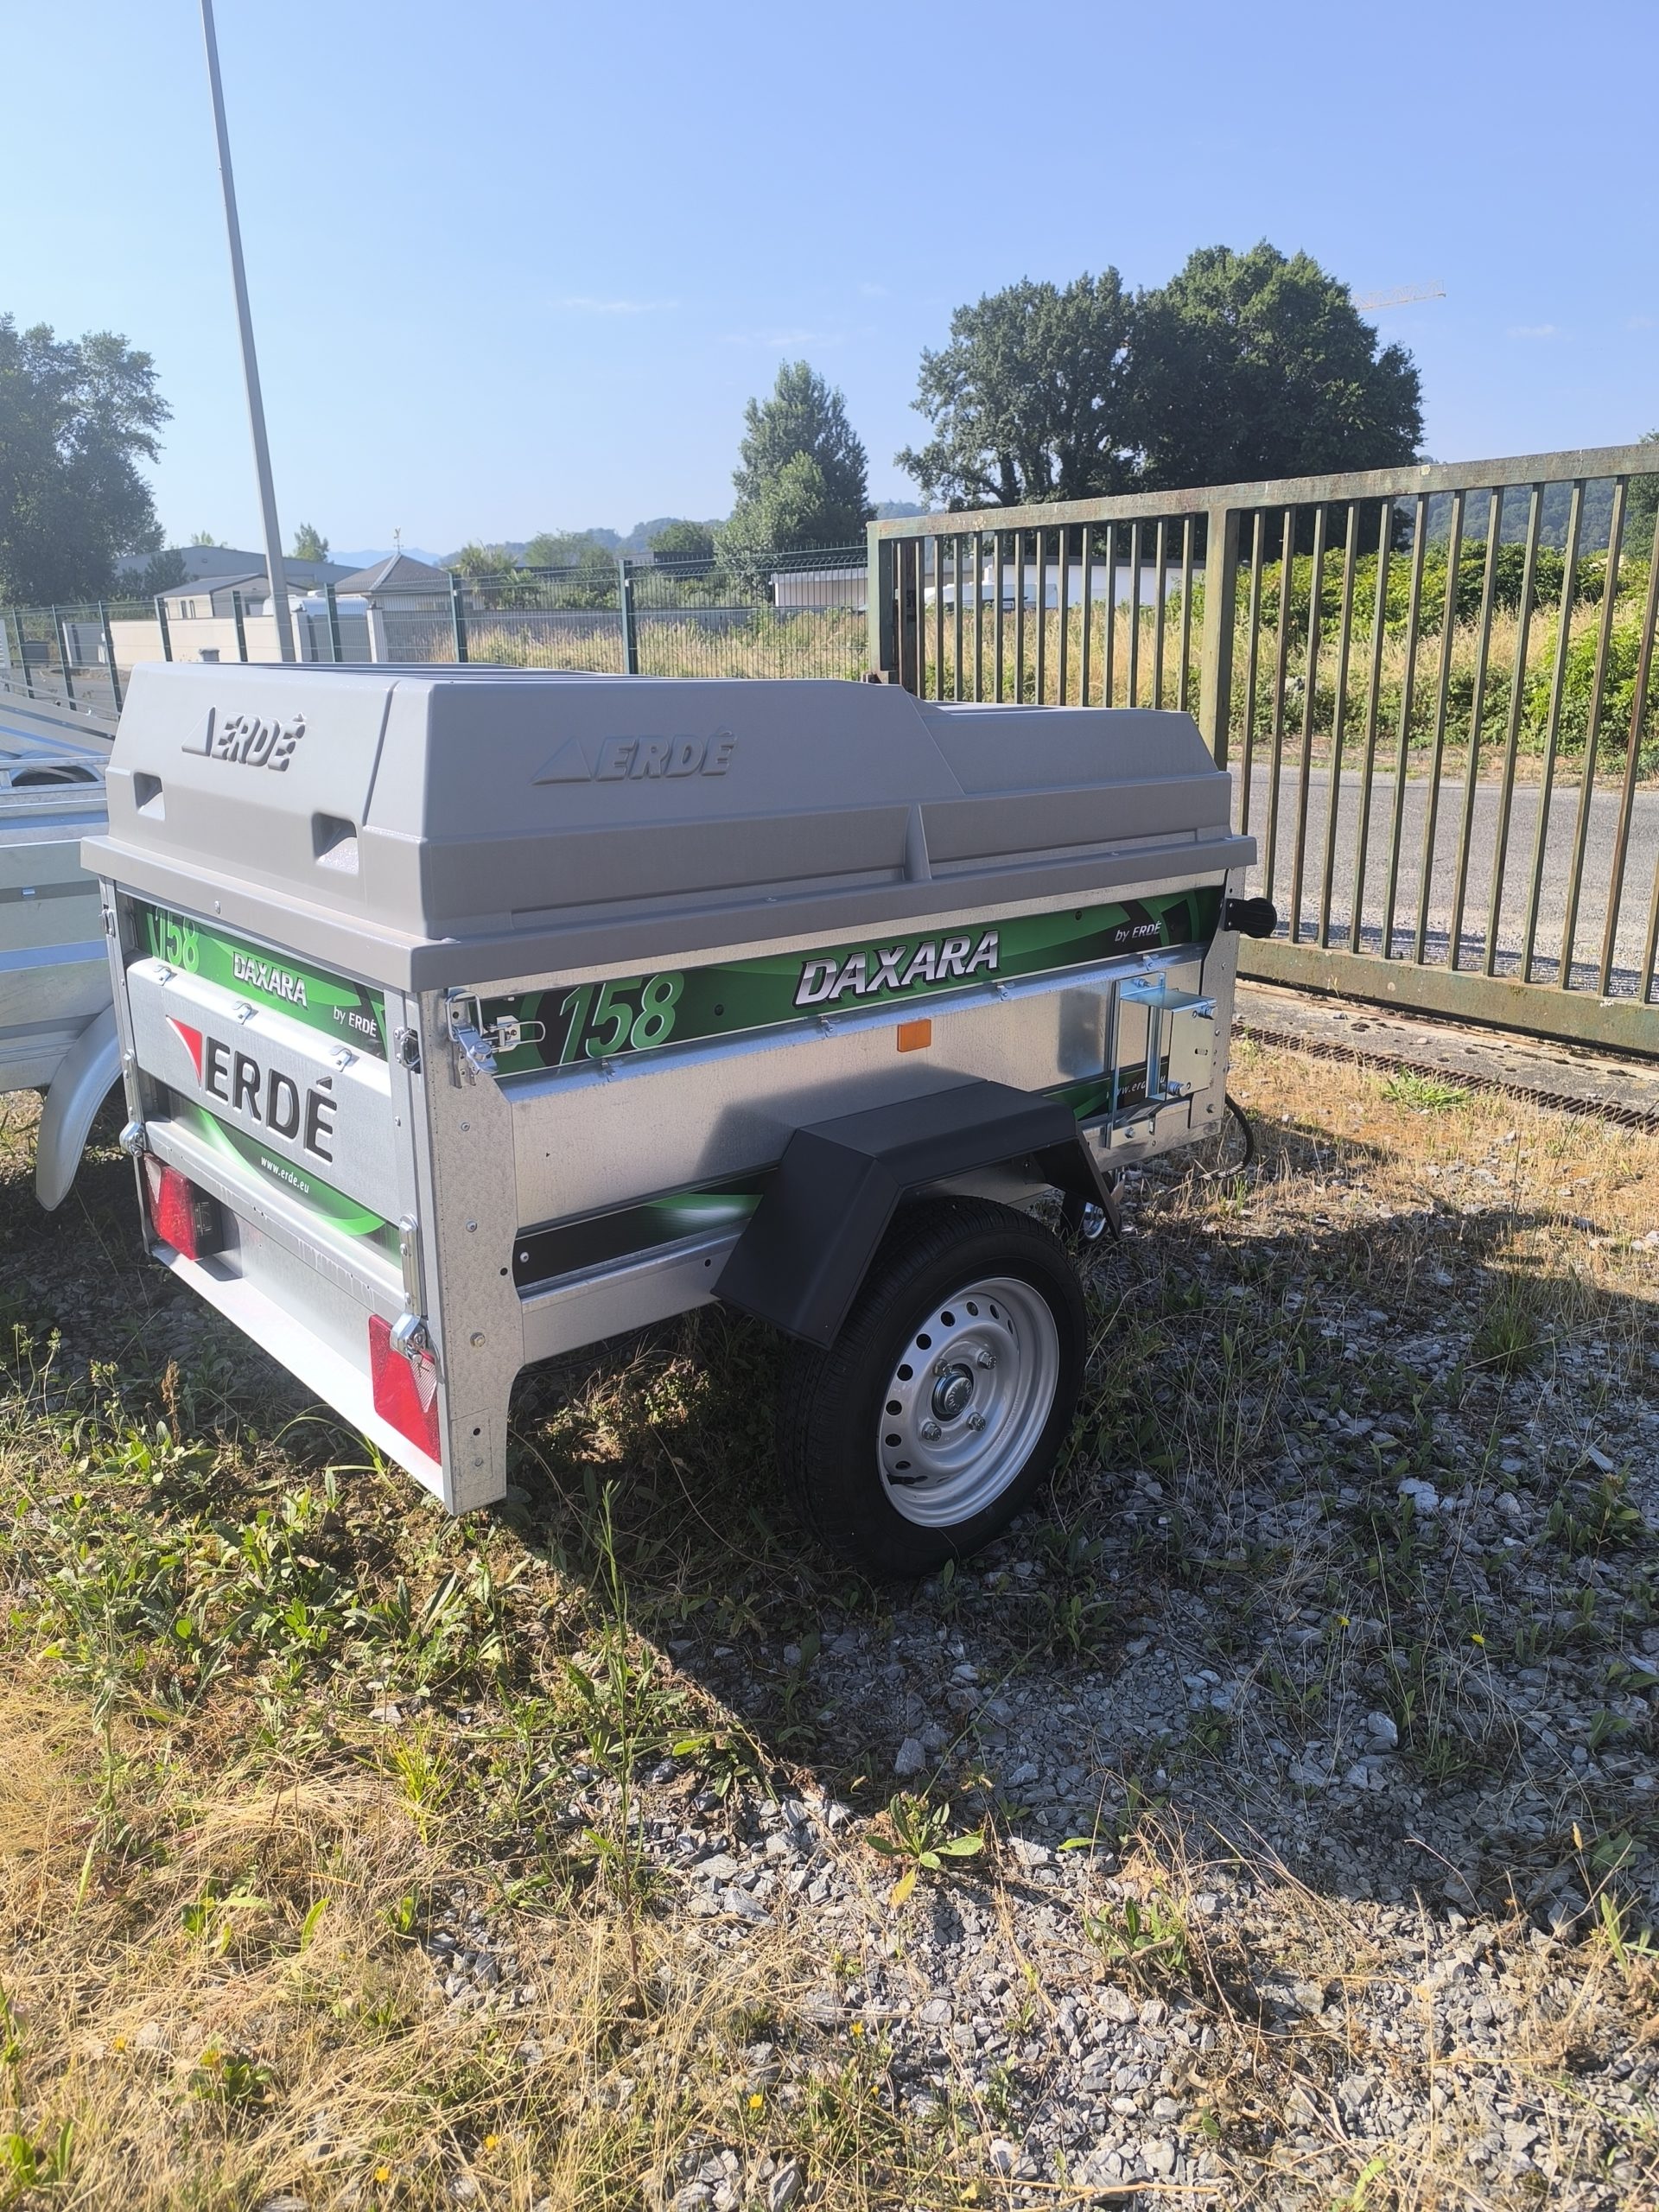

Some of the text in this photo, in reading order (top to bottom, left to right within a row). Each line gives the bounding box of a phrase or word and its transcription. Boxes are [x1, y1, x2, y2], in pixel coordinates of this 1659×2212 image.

[211, 711, 307, 772] ERDÉ
[594, 726, 738, 783] ERDÉ
[155, 906, 200, 975] 158
[1114, 920, 1162, 943] by ERDÉ
[232, 950, 308, 1010] DAXARA
[792, 929, 1000, 1007] DAXARA
[333, 1005, 378, 1038] by ERDÉ
[559, 970, 685, 1065] 158
[205, 1035, 338, 1166] ERDÉ
[260, 1156, 310, 1194] www.erde.eu
